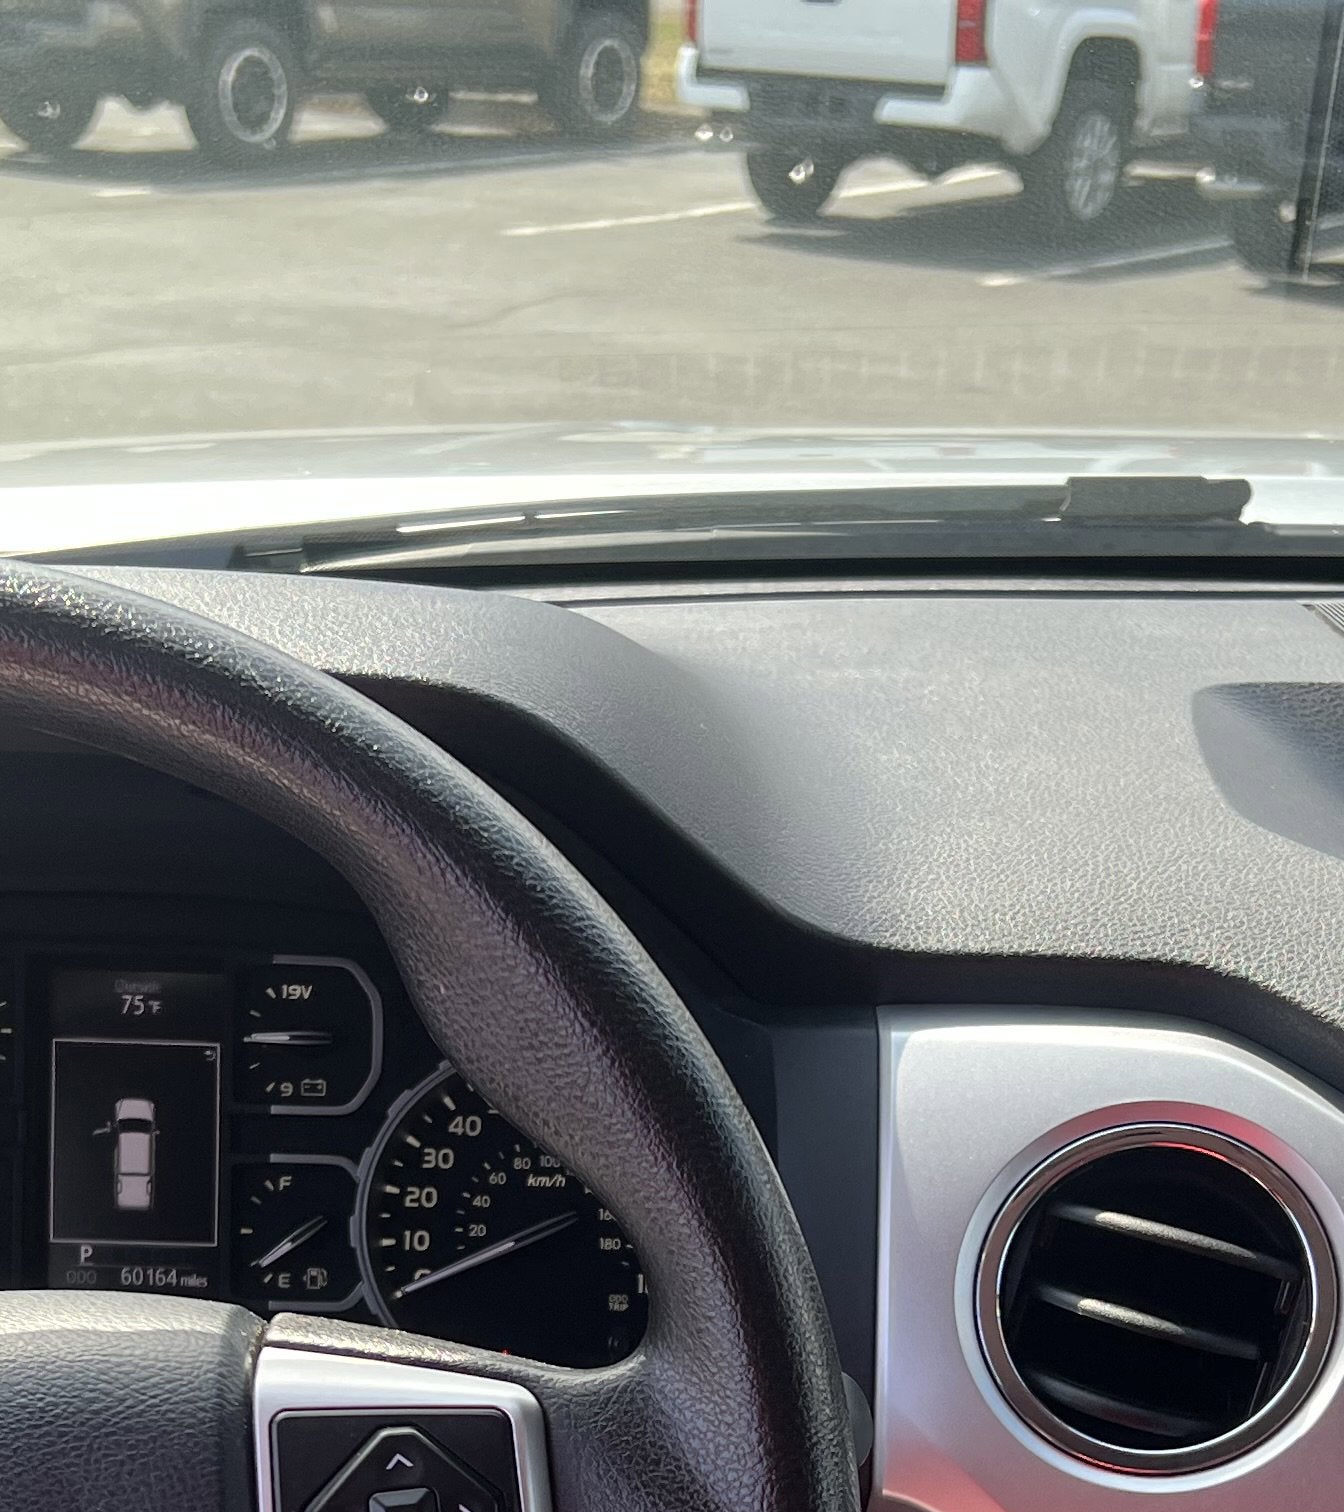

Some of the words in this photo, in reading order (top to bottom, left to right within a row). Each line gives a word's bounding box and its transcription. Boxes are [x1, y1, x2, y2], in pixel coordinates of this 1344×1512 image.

[281, 984, 313, 1000] 19V
[279, 1082, 294, 1097] 9
[448, 1115, 482, 1137] 40
[422, 1148, 454, 1169] 30
[513, 1157, 531, 1170] 80
[279, 1176, 292, 1191] F
[489, 1172, 506, 1185] 60
[527, 1173, 566, 1188] km/h
[404, 1187, 438, 1208] 20
[473, 1195, 490, 1208] 40
[469, 1224, 486, 1238] 20
[404, 1230, 430, 1251] 10
[600, 1238, 621, 1250] 180
[80, 1245, 93, 1265] P
[121, 1266, 178, 1287] 60164
[180, 1275, 208, 1288] miles
[278, 1273, 291, 1289] E
